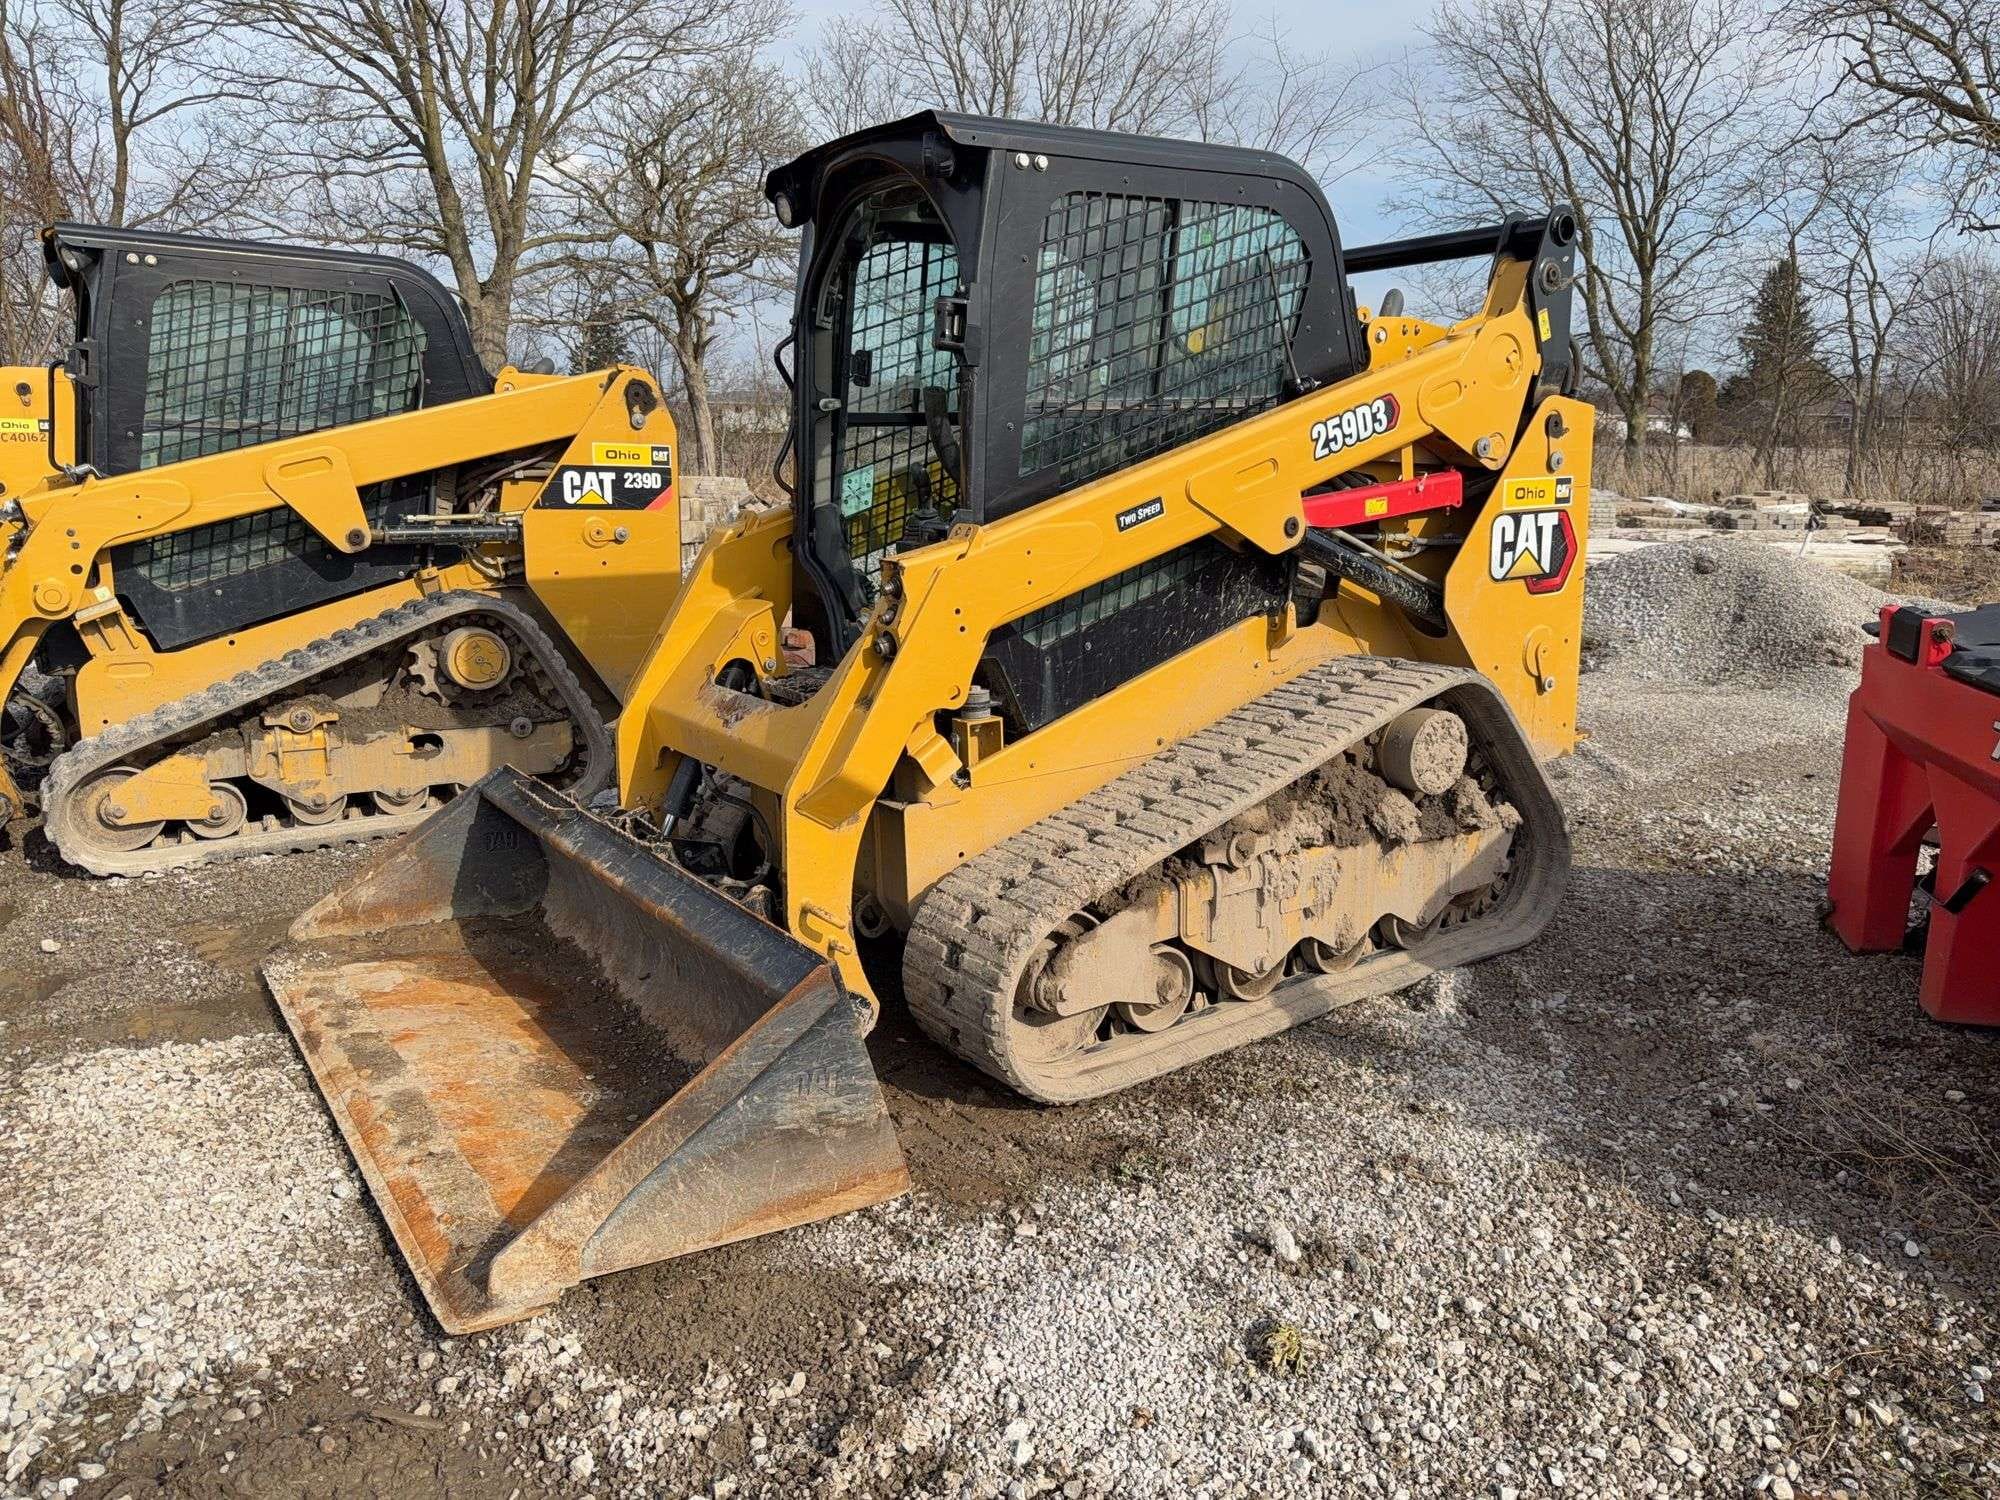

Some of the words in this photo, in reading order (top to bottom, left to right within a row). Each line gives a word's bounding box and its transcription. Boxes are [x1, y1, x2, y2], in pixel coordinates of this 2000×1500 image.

[1, 421, 30, 430] Ohio
[1311, 398, 1388, 459] 259D3
[605, 449, 641, 460] Ohio
[652, 450, 669, 462] CAT
[562, 470, 616, 505] CAT
[623, 472, 662, 489] 239D
[1515, 487, 1546, 500] Ohio
[1119, 512, 1137, 528] TWO
[1137, 502, 1161, 520] SPEED
[1491, 511, 1559, 580] CAT
